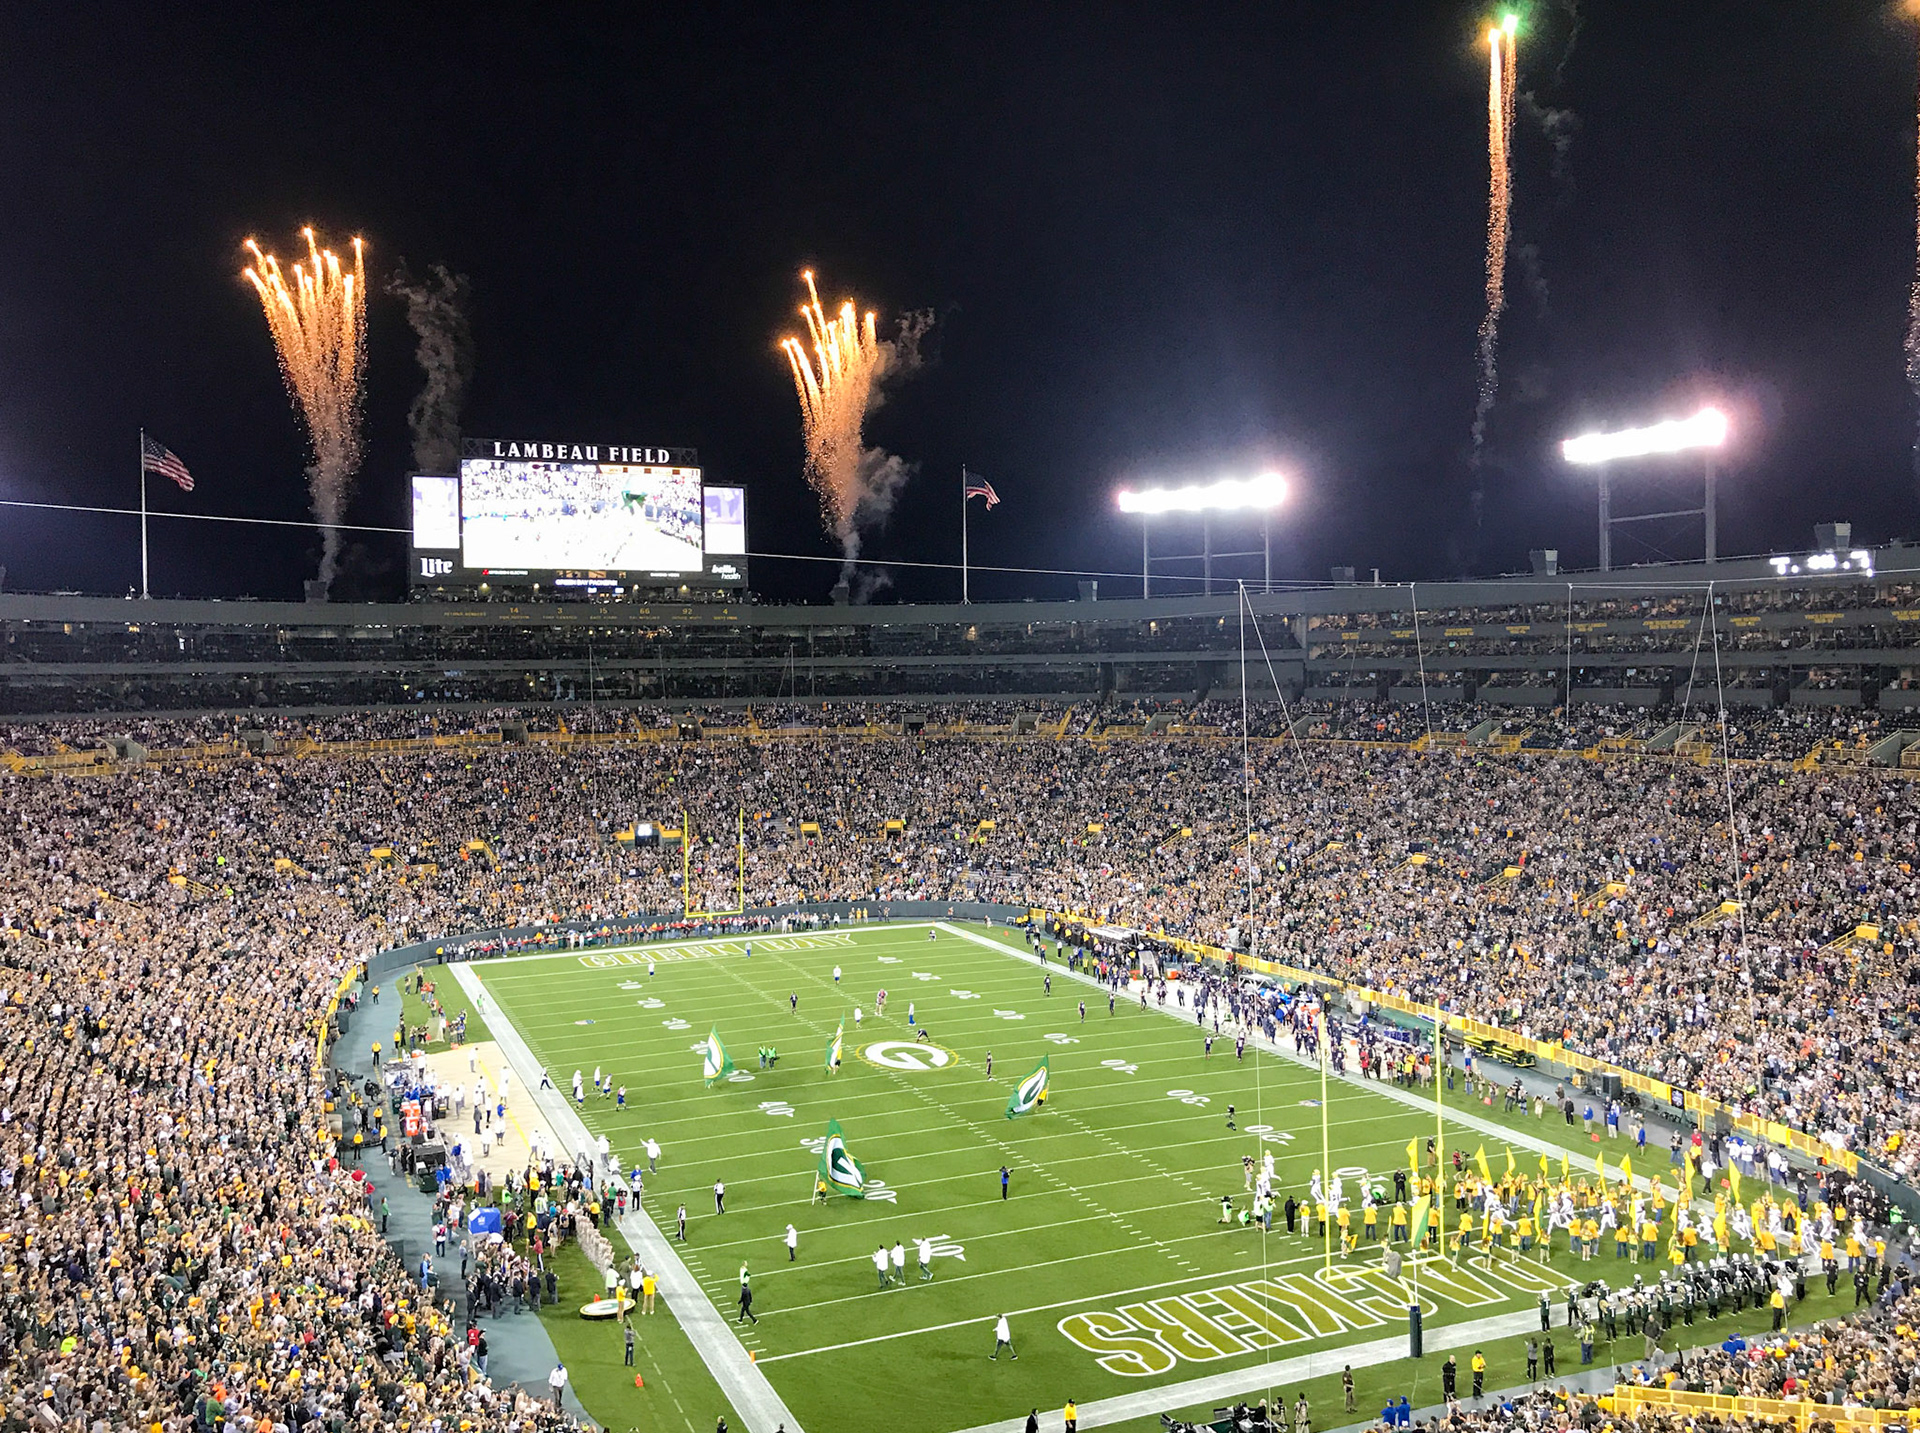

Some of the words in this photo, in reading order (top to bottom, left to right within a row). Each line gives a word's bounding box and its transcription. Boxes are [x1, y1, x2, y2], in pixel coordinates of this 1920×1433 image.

[494, 441, 599, 461] LAMBEAU
[609, 447, 671, 464] FIELD
[420, 557, 454, 578] Lite
[599, 607, 608, 615] 15
[639, 607, 650, 615] 66
[578, 942, 745, 968] GREEN
[753, 933, 858, 952] BAY
[1043, 1033, 1081, 1045] 50
[1100, 1059, 1139, 1076] 40
[1166, 1089, 1211, 1108] 30
[758, 1101, 796, 1118] 40
[1243, 1124, 1296, 1146] 20
[1057, 1239, 1584, 1377] PACKERS
